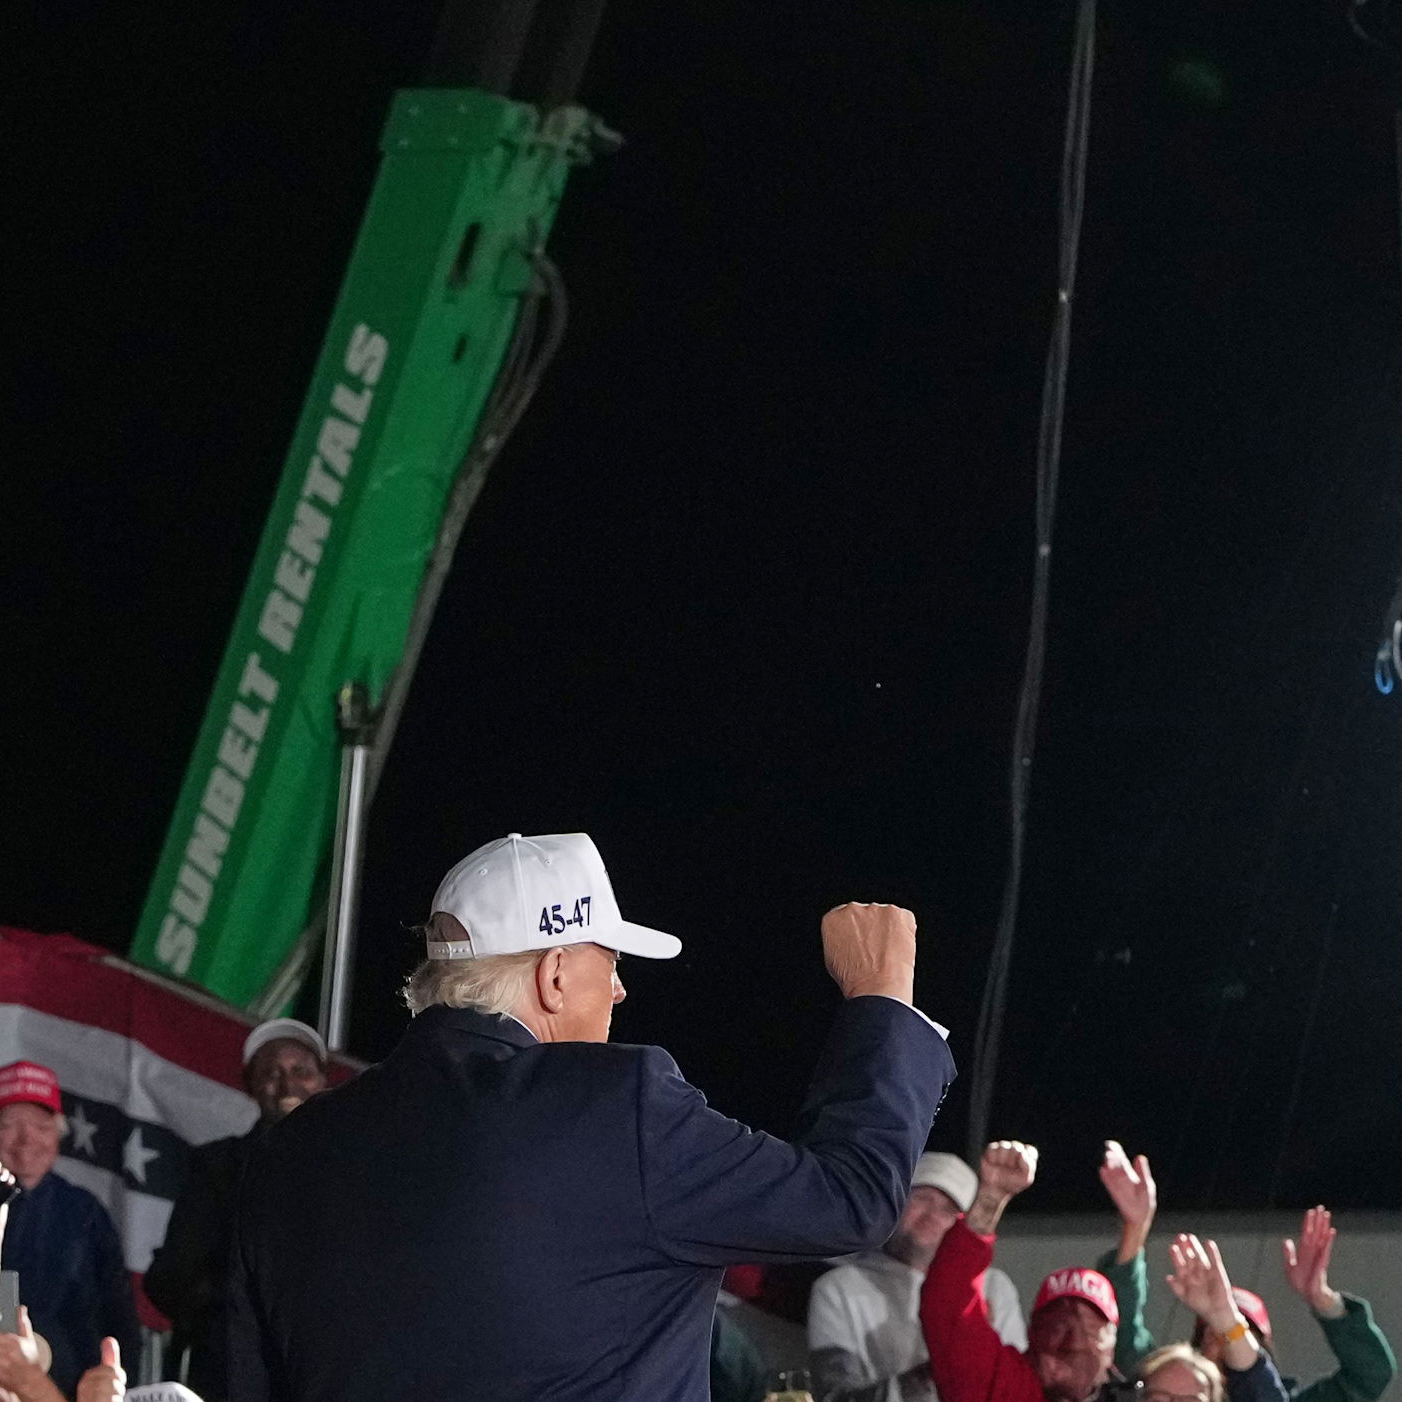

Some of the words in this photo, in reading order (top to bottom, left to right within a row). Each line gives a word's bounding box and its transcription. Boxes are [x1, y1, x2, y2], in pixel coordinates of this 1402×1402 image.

[153, 652, 281, 976] SUNBELT
[258, 323, 390, 653] RENTALS
[539, 896, 591, 935] 45-47
